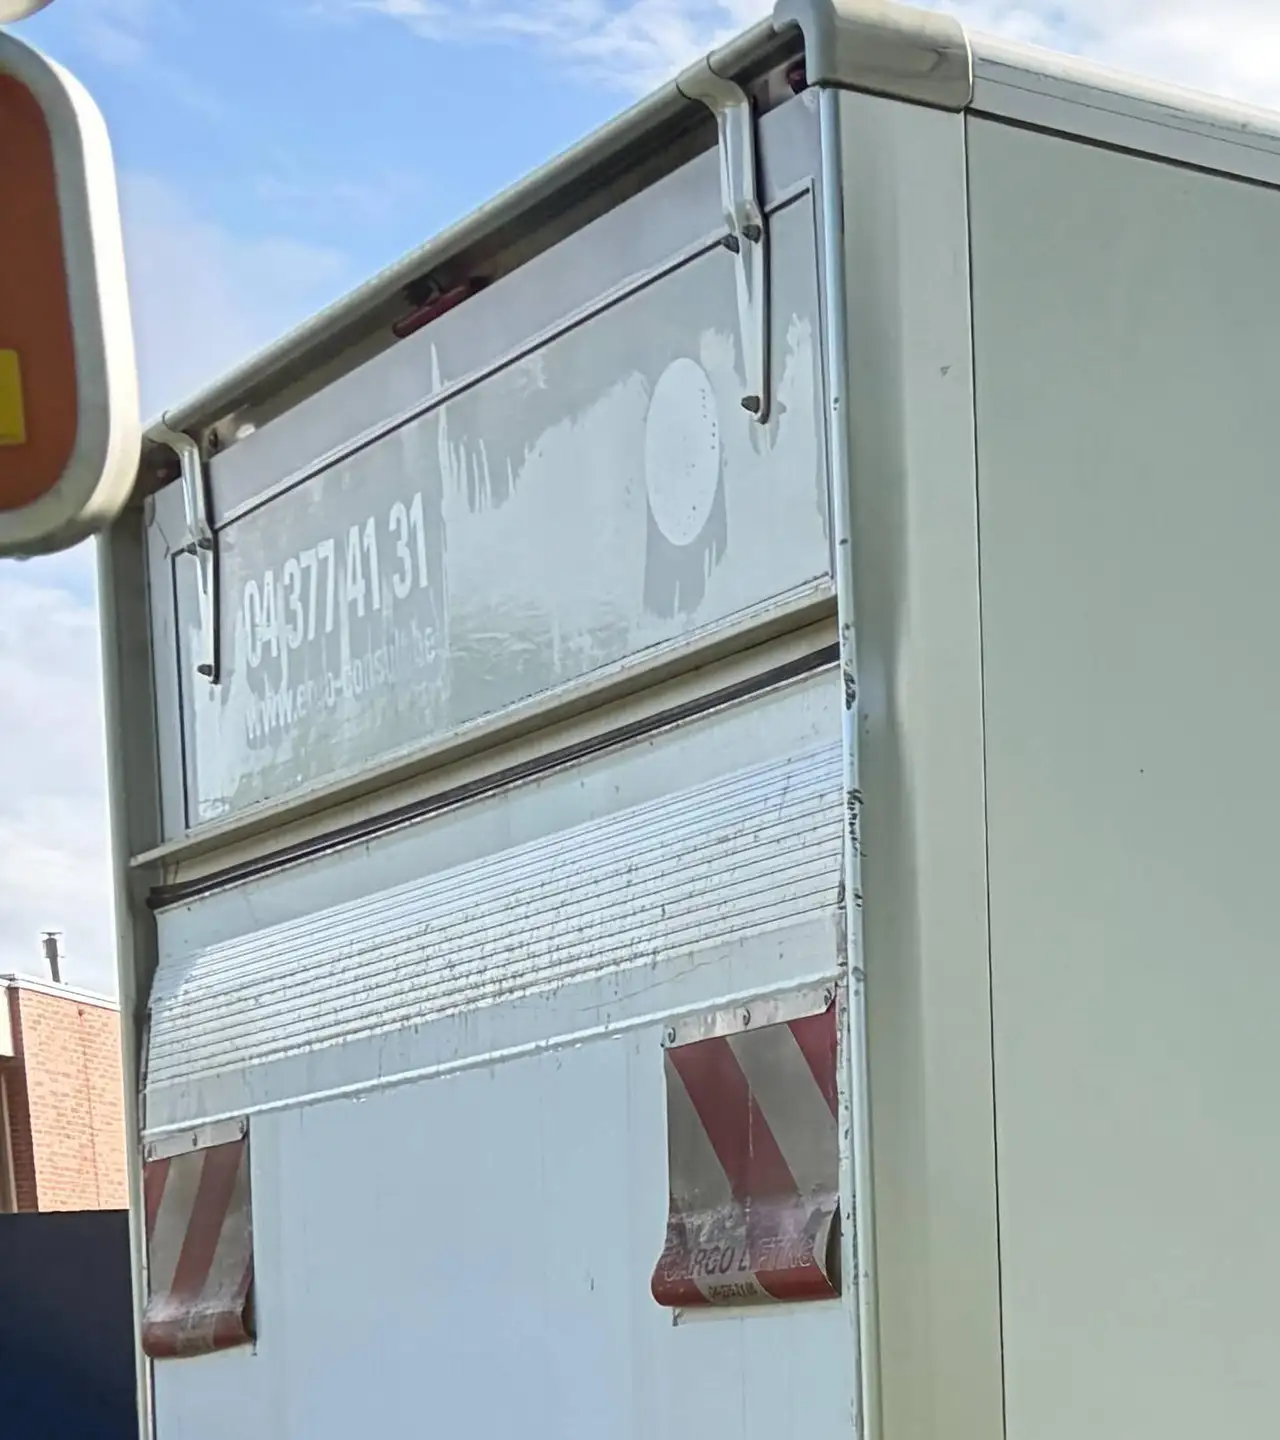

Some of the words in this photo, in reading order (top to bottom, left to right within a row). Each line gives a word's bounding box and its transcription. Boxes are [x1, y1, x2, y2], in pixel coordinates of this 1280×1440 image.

[243, 570, 279, 668] 04
[283, 537, 335, 650] 377
[346, 515, 381, 618] 41
[388, 491, 429, 600] 31
